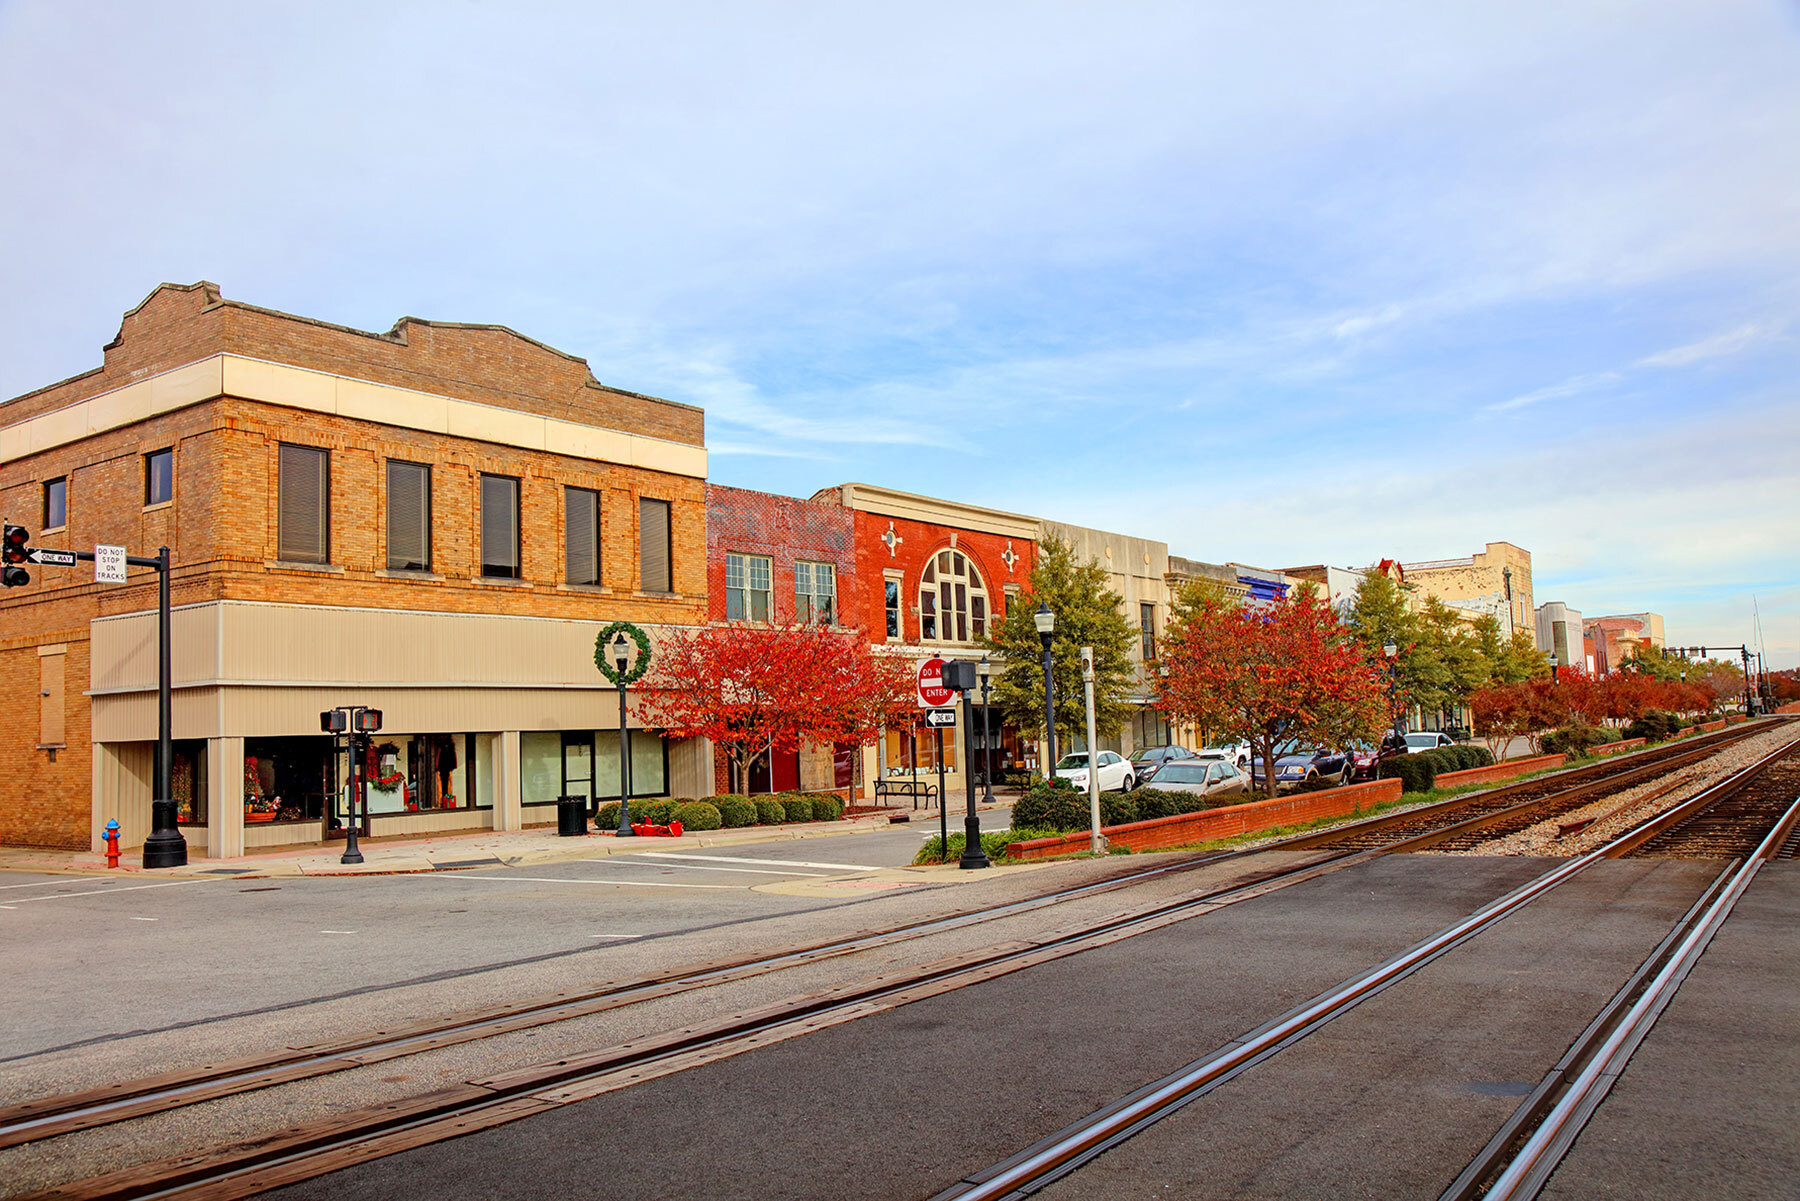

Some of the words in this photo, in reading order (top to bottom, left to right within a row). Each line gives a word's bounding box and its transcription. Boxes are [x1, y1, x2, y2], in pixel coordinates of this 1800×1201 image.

[922, 668, 932, 676] DO
[926, 688, 948, 697] ENTER
[936, 714, 944, 722] ONE
